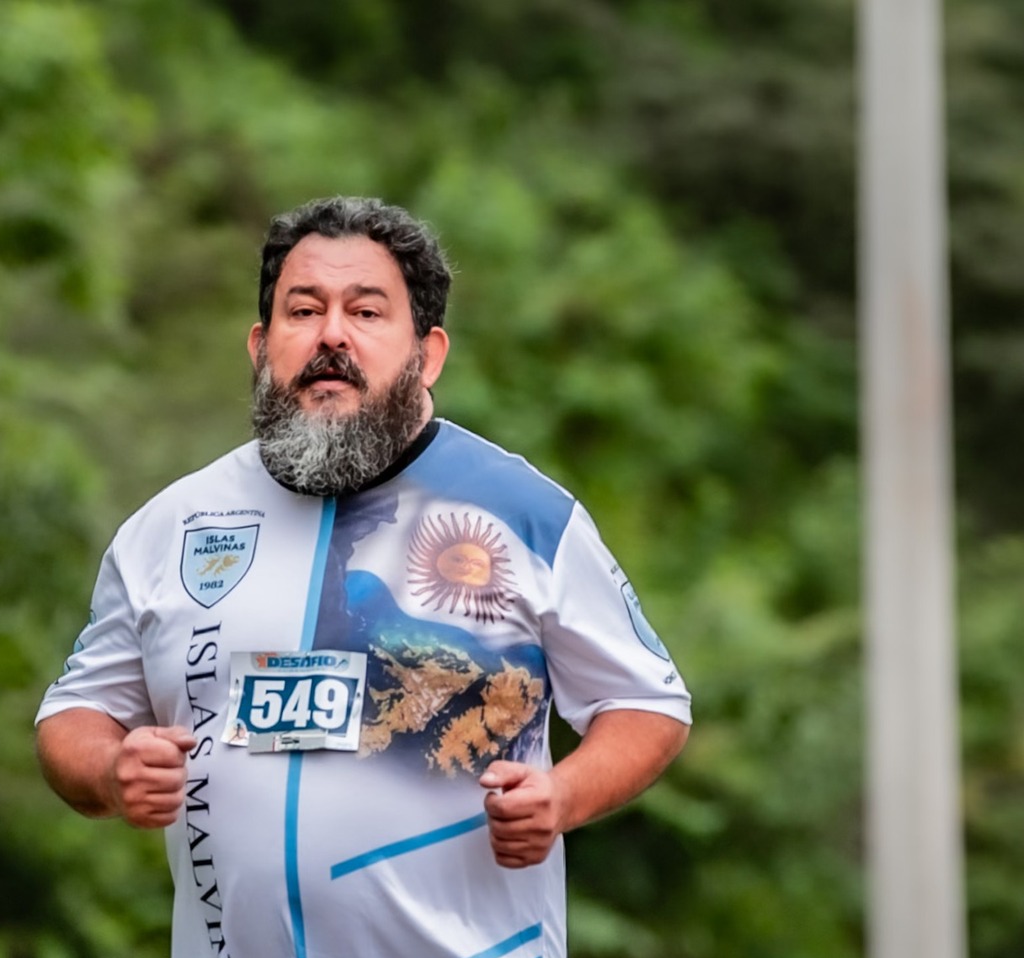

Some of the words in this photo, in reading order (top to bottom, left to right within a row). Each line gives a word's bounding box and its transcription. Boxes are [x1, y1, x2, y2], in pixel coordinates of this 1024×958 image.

[225, 509, 266, 518] ARGENTINA
[205, 534, 236, 545] ISLAS
[193, 542, 246, 556] MALVINAS
[199, 579, 224, 591] 1982
[185, 620, 223, 761] ISLAS
[249, 678, 349, 729] 549
